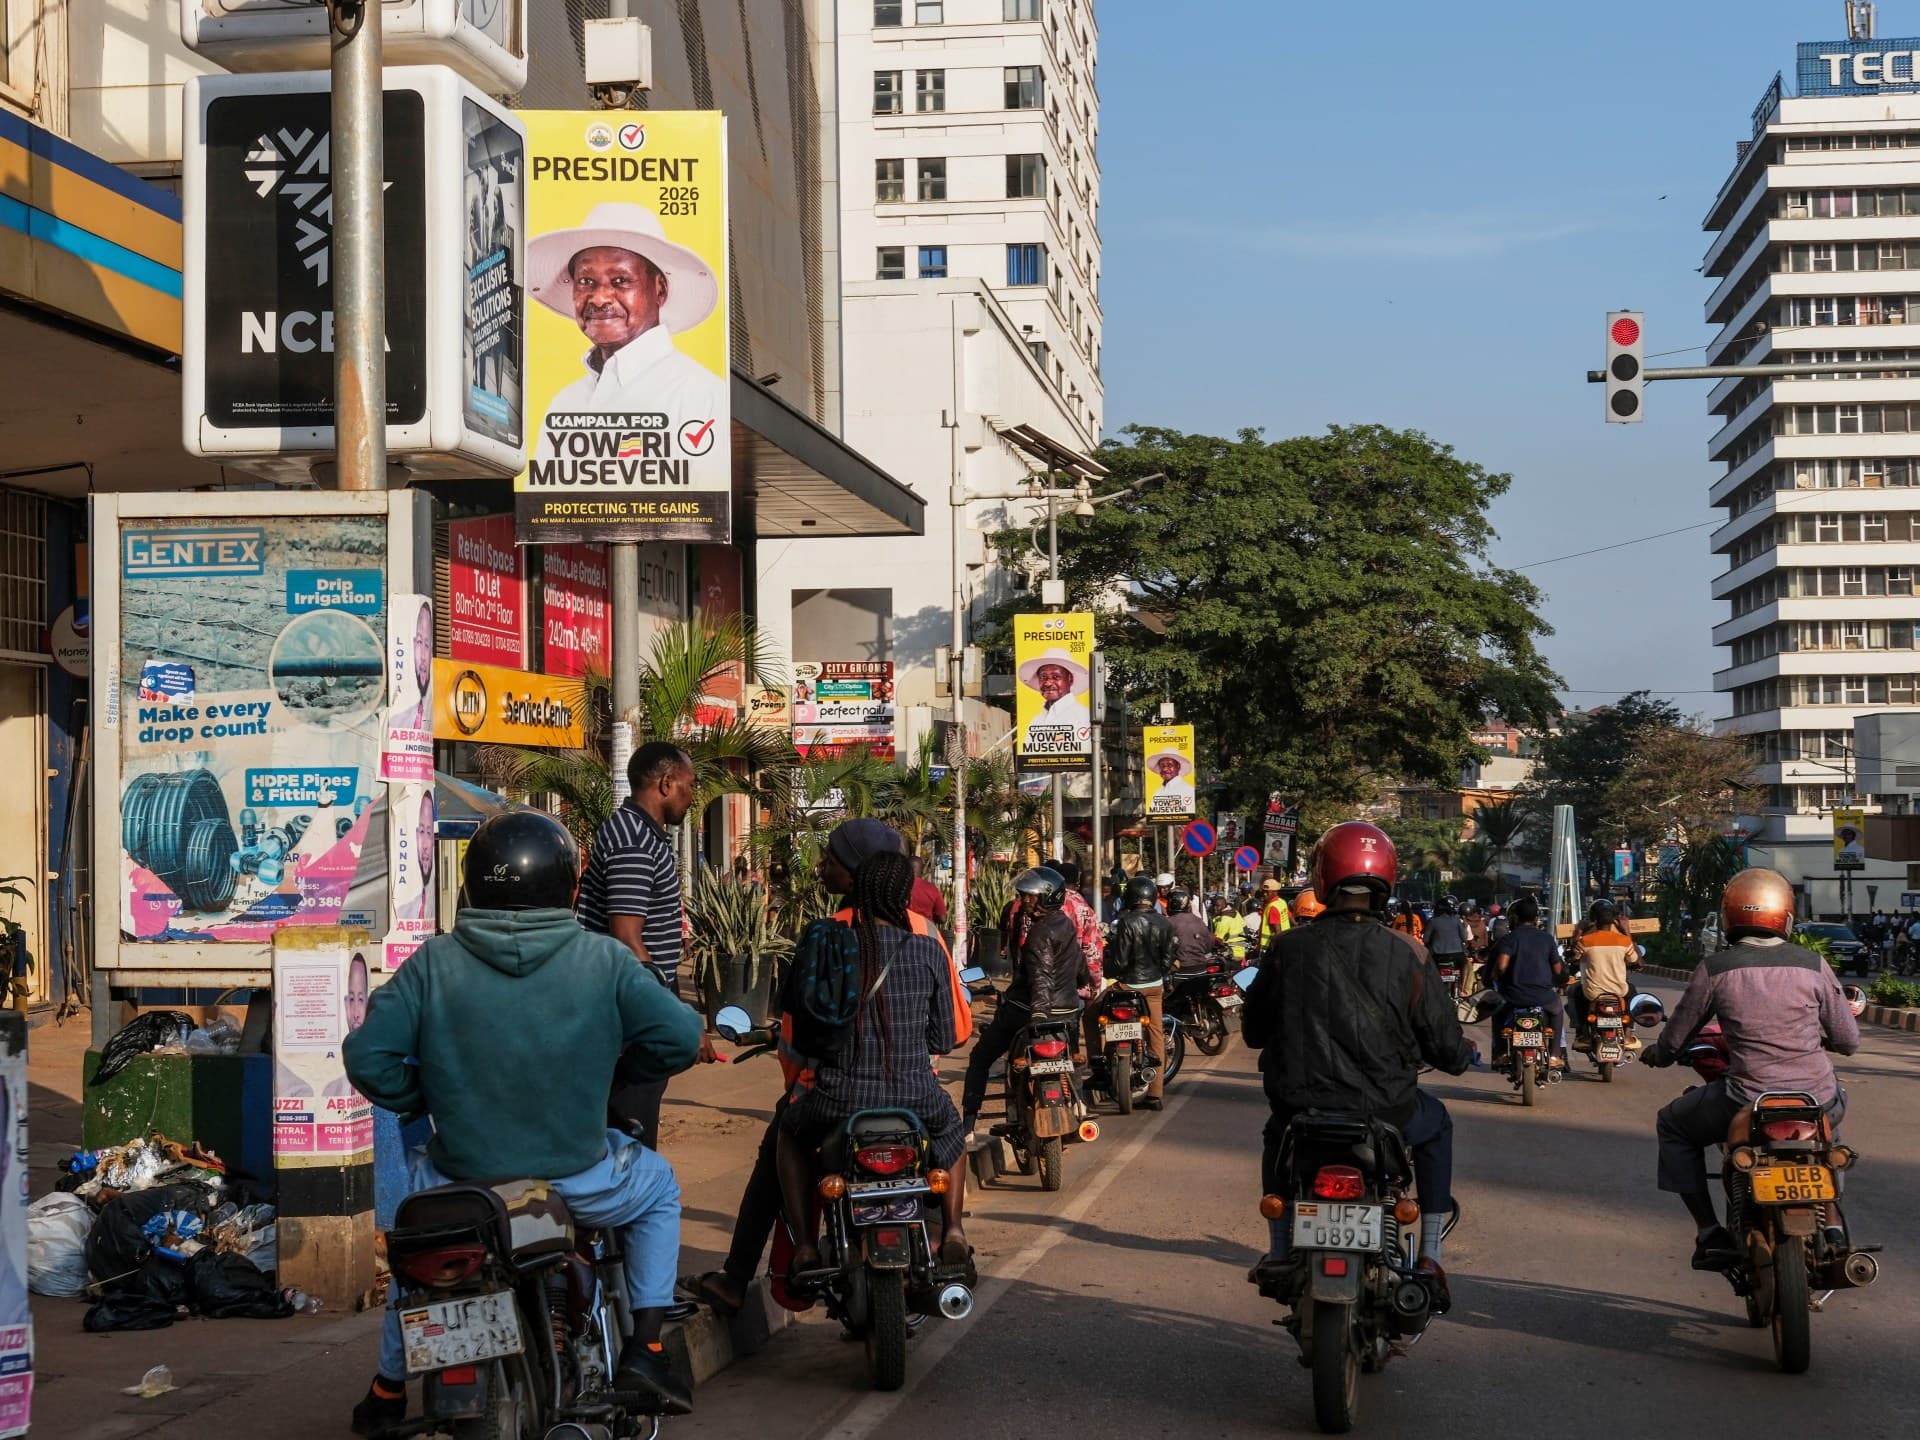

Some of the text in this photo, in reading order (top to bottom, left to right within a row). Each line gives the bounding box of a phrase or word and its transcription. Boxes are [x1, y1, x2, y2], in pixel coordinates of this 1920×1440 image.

[533, 156, 699, 183] PRESIDENT
[659, 187, 699, 201] 2026
[659, 202, 698, 216] 2031
[470, 262, 508, 304] EXCLUSIVE
[471, 286, 512, 330] SOLUTIONS
[241, 312, 391, 353] NC
[551, 414, 664, 428] KAMPALA FOR
[528, 459, 689, 486] MUSEVENI
[544, 502, 700, 515] PROTECTING THE GAINS
[127, 534, 260, 566] GENTEX
[458, 533, 515, 576] Retail Space
[579, 560, 601, 587] Grade
[601, 567, 608, 589] A
[317, 578, 353, 592] Drip
[474, 569, 501, 599] To Let
[294, 591, 376, 607] Irrigation
[543, 582, 565, 609] Office
[565, 590, 585, 618] Spce
[594, 598, 604, 619] Let
[475, 598, 485, 619] On
[497, 604, 514, 625] Floor
[1024, 631, 1085, 641] PRESIDENT
[826, 663, 887, 673] CITY GROOMS
[460, 690, 480, 714] MTN
[502, 691, 573, 729] Service Centre
[139, 701, 272, 724] Make every
[820, 705, 861, 719] perfect
[862, 705, 886, 716] nails
[139, 726, 194, 743] drop
[1149, 736, 1188, 744] PRESIDENT
[1022, 742, 1082, 753] MUSEVENI
[251, 774, 300, 787] HDPE
[252, 788, 264, 802] &
[399, 828, 408, 884] LONDA
[254, 890, 269, 898] Tel:
[318, 896, 342, 907] 386
[273, 1099, 304, 1110] UZZI
[325, 1126, 342, 1134] FOR
[1784, 1167, 1822, 1183] UEB
[1327, 1204, 1372, 1225] UFZ
